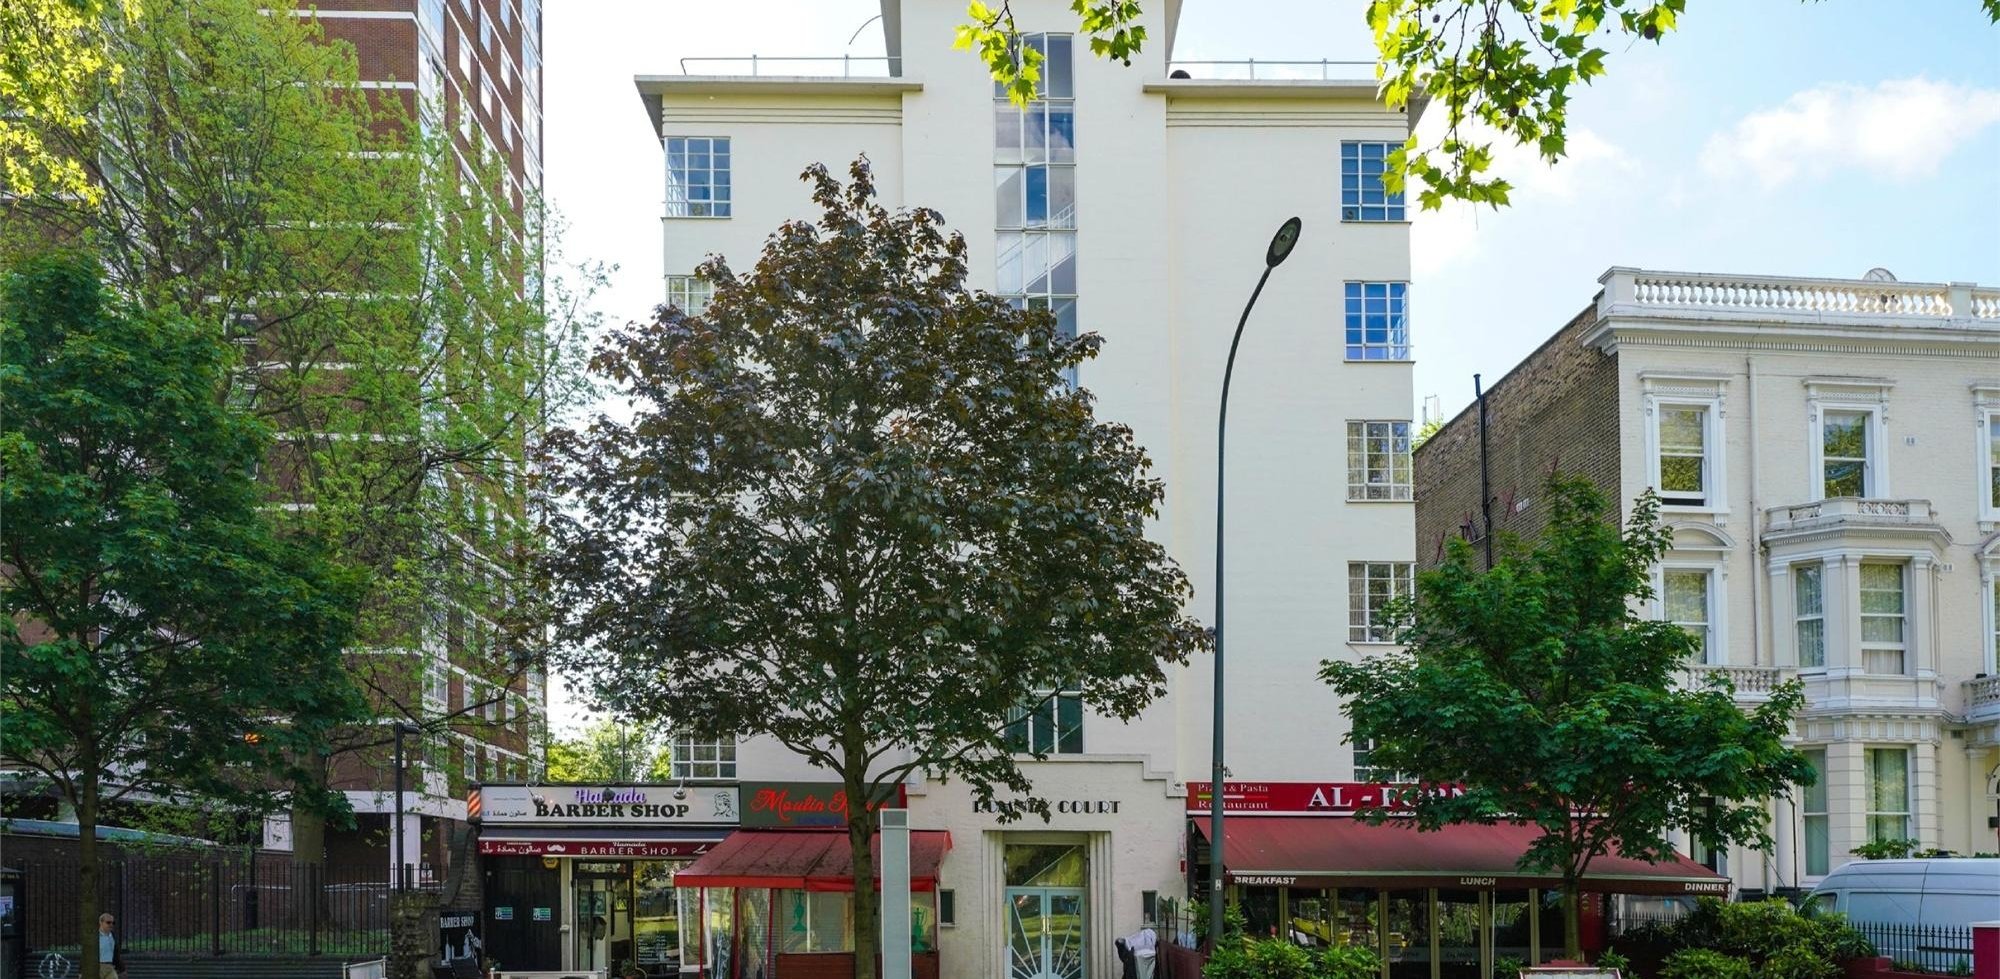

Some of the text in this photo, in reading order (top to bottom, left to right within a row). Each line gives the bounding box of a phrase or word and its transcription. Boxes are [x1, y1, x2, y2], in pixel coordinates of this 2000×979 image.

[1229, 784, 1236, 792] &
[1240, 783, 1268, 792] Pasta
[1308, 787, 1352, 807] AL
[750, 788, 825, 822] Moulin
[1057, 800, 1121, 814] COURT
[1198, 800, 1269, 809] Retaurant
[535, 804, 689, 818] BARBER SHOP
[581, 847, 678, 855] BARBER SHOP
[1234, 876, 1297, 885] BREAKFAST
[1460, 877, 1497, 886] LUNCH
[1684, 882, 1725, 892] DINNER
[440, 916, 461, 929] BARBER
